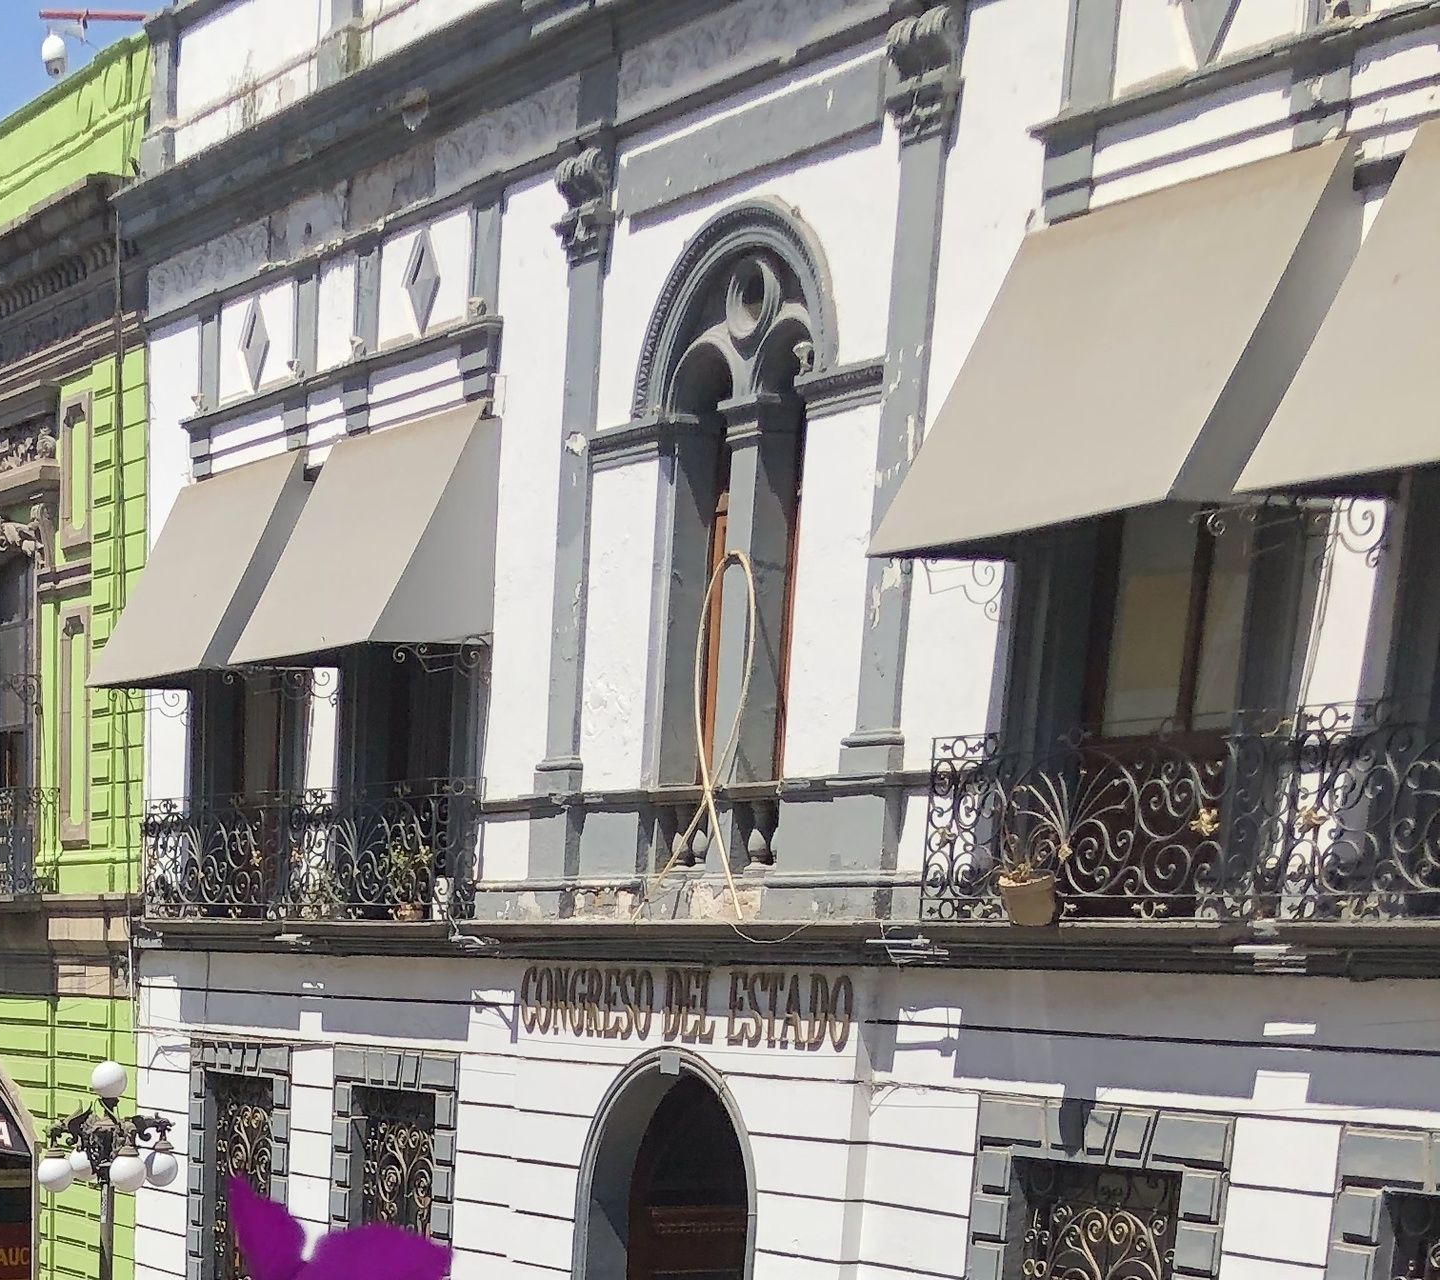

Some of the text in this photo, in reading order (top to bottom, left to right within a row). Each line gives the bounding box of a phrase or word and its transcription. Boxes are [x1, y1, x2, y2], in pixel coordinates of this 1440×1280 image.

[521, 965, 855, 1054] CONGRESO DEL ESTADO
